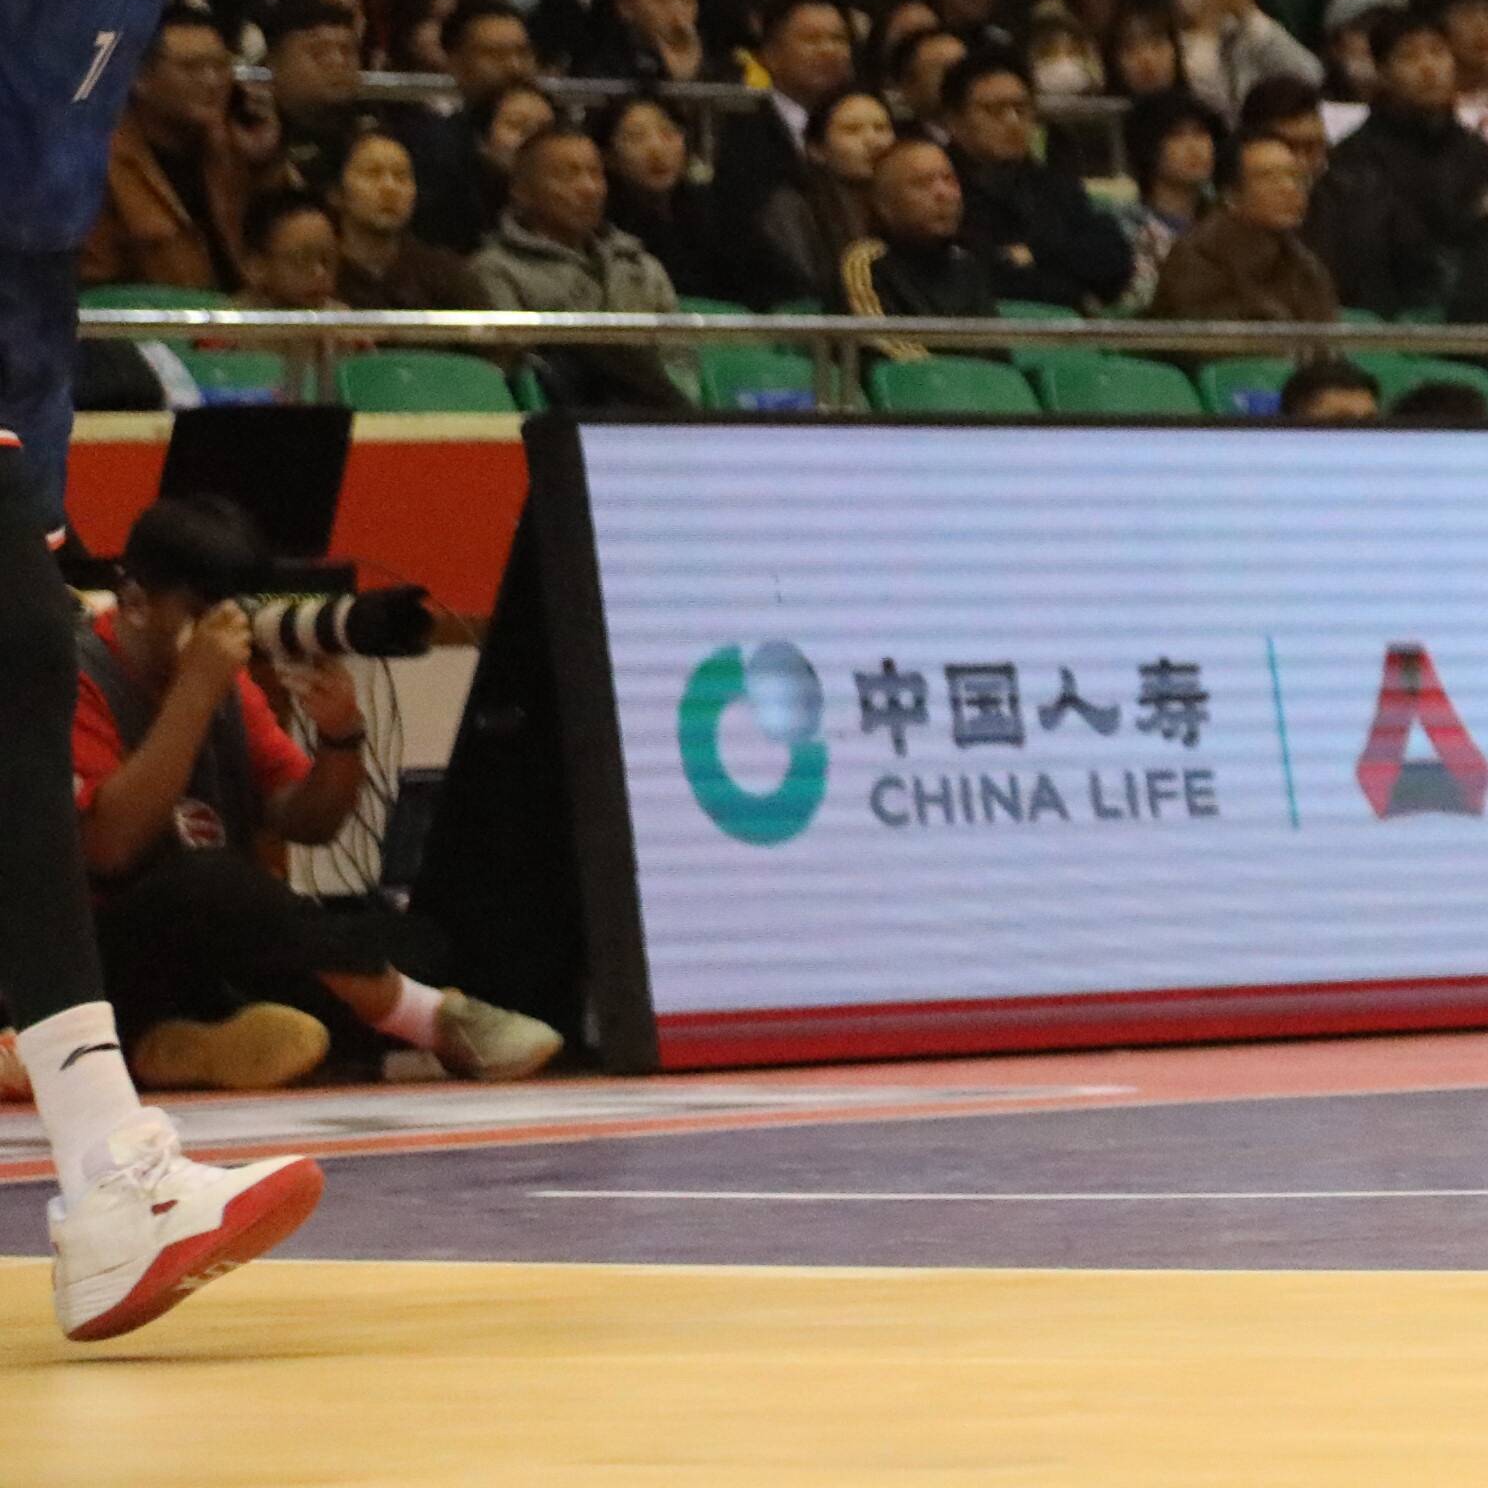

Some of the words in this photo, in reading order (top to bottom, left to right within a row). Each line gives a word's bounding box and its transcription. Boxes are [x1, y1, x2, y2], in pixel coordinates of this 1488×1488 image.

[851, 655, 1211, 756] 中国人寿
[869, 772, 1070, 827] CHINA
[1088, 768, 1220, 819] LIFE
